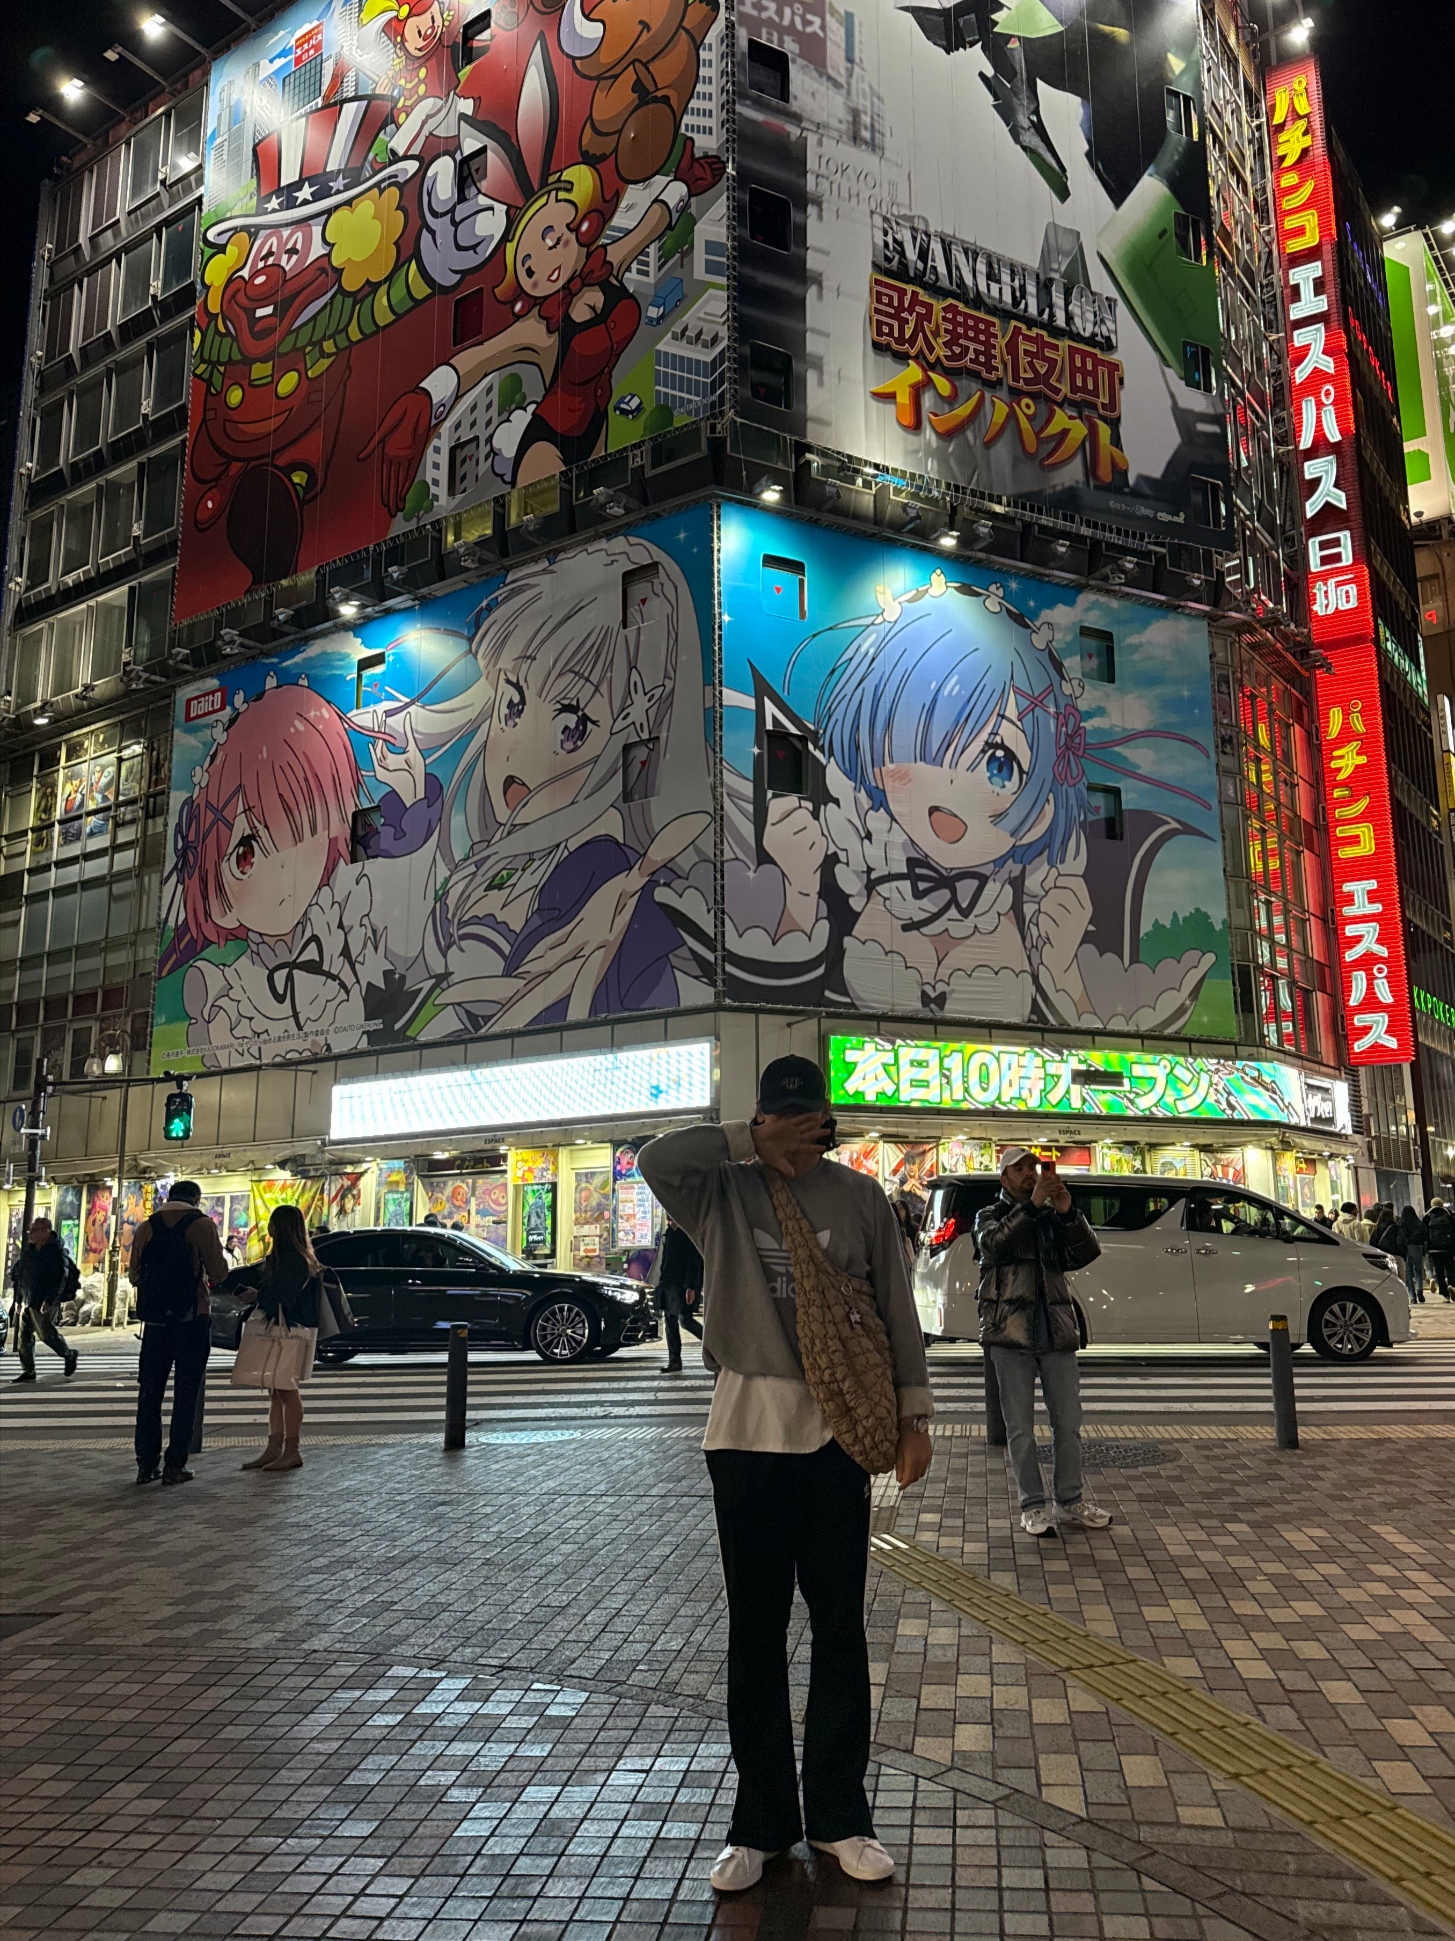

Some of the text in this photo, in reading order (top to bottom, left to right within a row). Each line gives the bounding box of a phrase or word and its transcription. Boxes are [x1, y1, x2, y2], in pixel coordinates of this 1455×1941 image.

[1273, 75, 1319, 253] パチンコ
[870, 273, 1124, 416] 歌舞伎町
[872, 213, 1117, 348] EVANGELION
[869, 357, 1129, 485] インパクト
[1288, 260, 1349, 520] エスパス
[1326, 691, 1398, 1053] パチンコ エスパス
[484, 1137, 505, 1145] ESPACE
